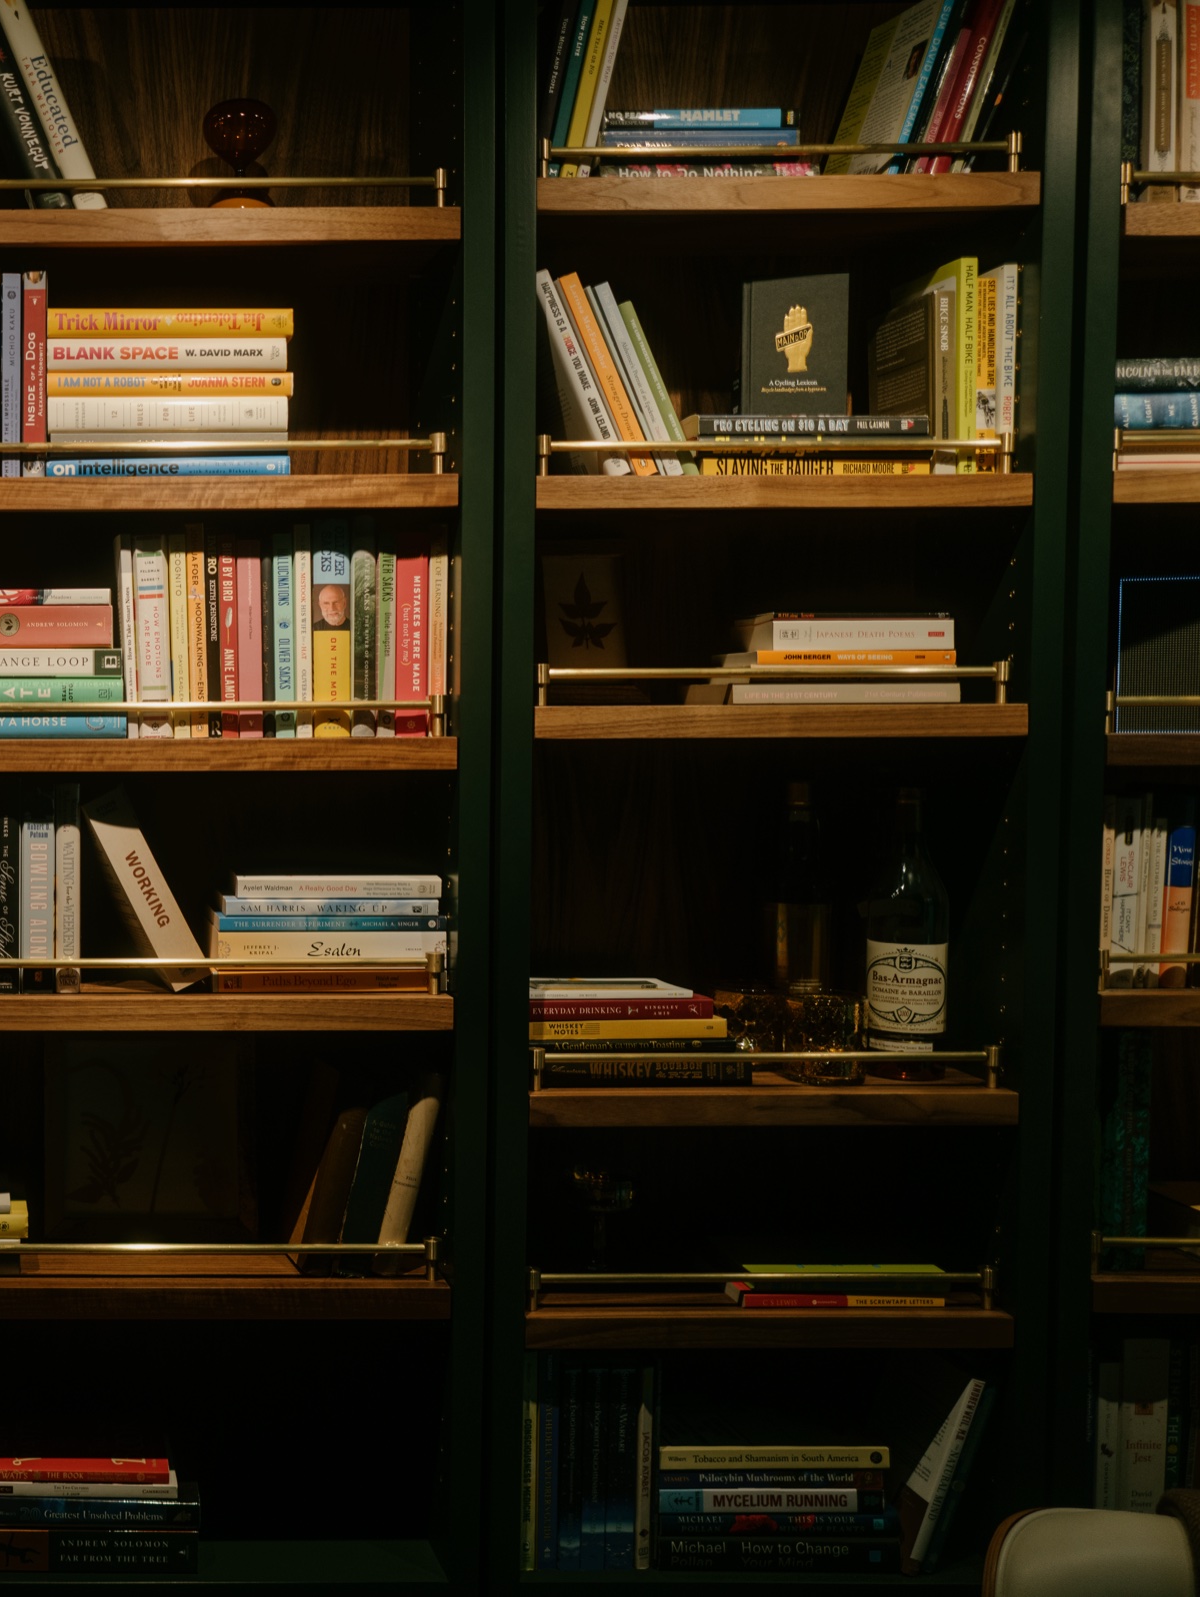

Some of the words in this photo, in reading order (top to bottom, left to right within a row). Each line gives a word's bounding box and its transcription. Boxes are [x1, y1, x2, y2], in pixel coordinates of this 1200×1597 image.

[924, 38, 940, 72] DAVID
[30, 54, 78, 148] Educated
[903, 76, 928, 136] EAGLEMAN
[0, 72, 23, 106] KURT
[14, 108, 48, 170] VONNEGUT
[680, 110, 740, 121] HAMLET
[55, 313, 99, 331] Trick
[103, 312, 161, 331] Mirror
[53, 347, 115, 360] BLANK
[120, 347, 179, 360] SPACE
[185, 349, 197, 357] W.
[200, 349, 231, 357] DAVID
[234, 349, 263, 357] MARX
[775, 379, 795, 387] Cycling
[53, 464, 76, 475] on
[78, 459, 179, 476] intelligence
[843, 463, 870, 474] RICHARD
[872, 463, 894, 474] MOORE
[413, 575, 421, 627] MISTAKES
[413, 631, 421, 660] WERE
[47, 657, 89, 667] LOOP
[224, 648, 234, 672] ANNE
[412, 663, 420, 692] MADE
[124, 850, 170, 928] WORKING
[307, 942, 361, 957] Esalen
[872, 970, 942, 986] Bas-Armagnac
[872, 986, 899, 995] DOMAINE
[532, 1007, 577, 1015] EVERYDAY
[693, 1454, 726, 1463] Tobacco
[728, 1455, 743, 1463] and
[745, 1454, 789, 1462] Shamanism
[791, 1453, 799, 1462] in
[801, 1453, 825, 1462] South
[826, 1453, 859, 1463] America
[699, 1473, 743, 1483] Psilocybin
[746, 1473, 796, 1483] Mushrooms
[713, 1495, 783, 1507] MYCELIUM
[786, 1495, 848, 1507] RUNNING
[43, 1509, 80, 1521] Greatest
[82, 1510, 122, 1521] Unsolved
[124, 1511, 164, 1521] Problems
[59, 1554, 79, 1563] FAR
[83, 1555, 112, 1563] FROM
[115, 1555, 136, 1563] THE
[140, 1555, 169, 1564] TREE
